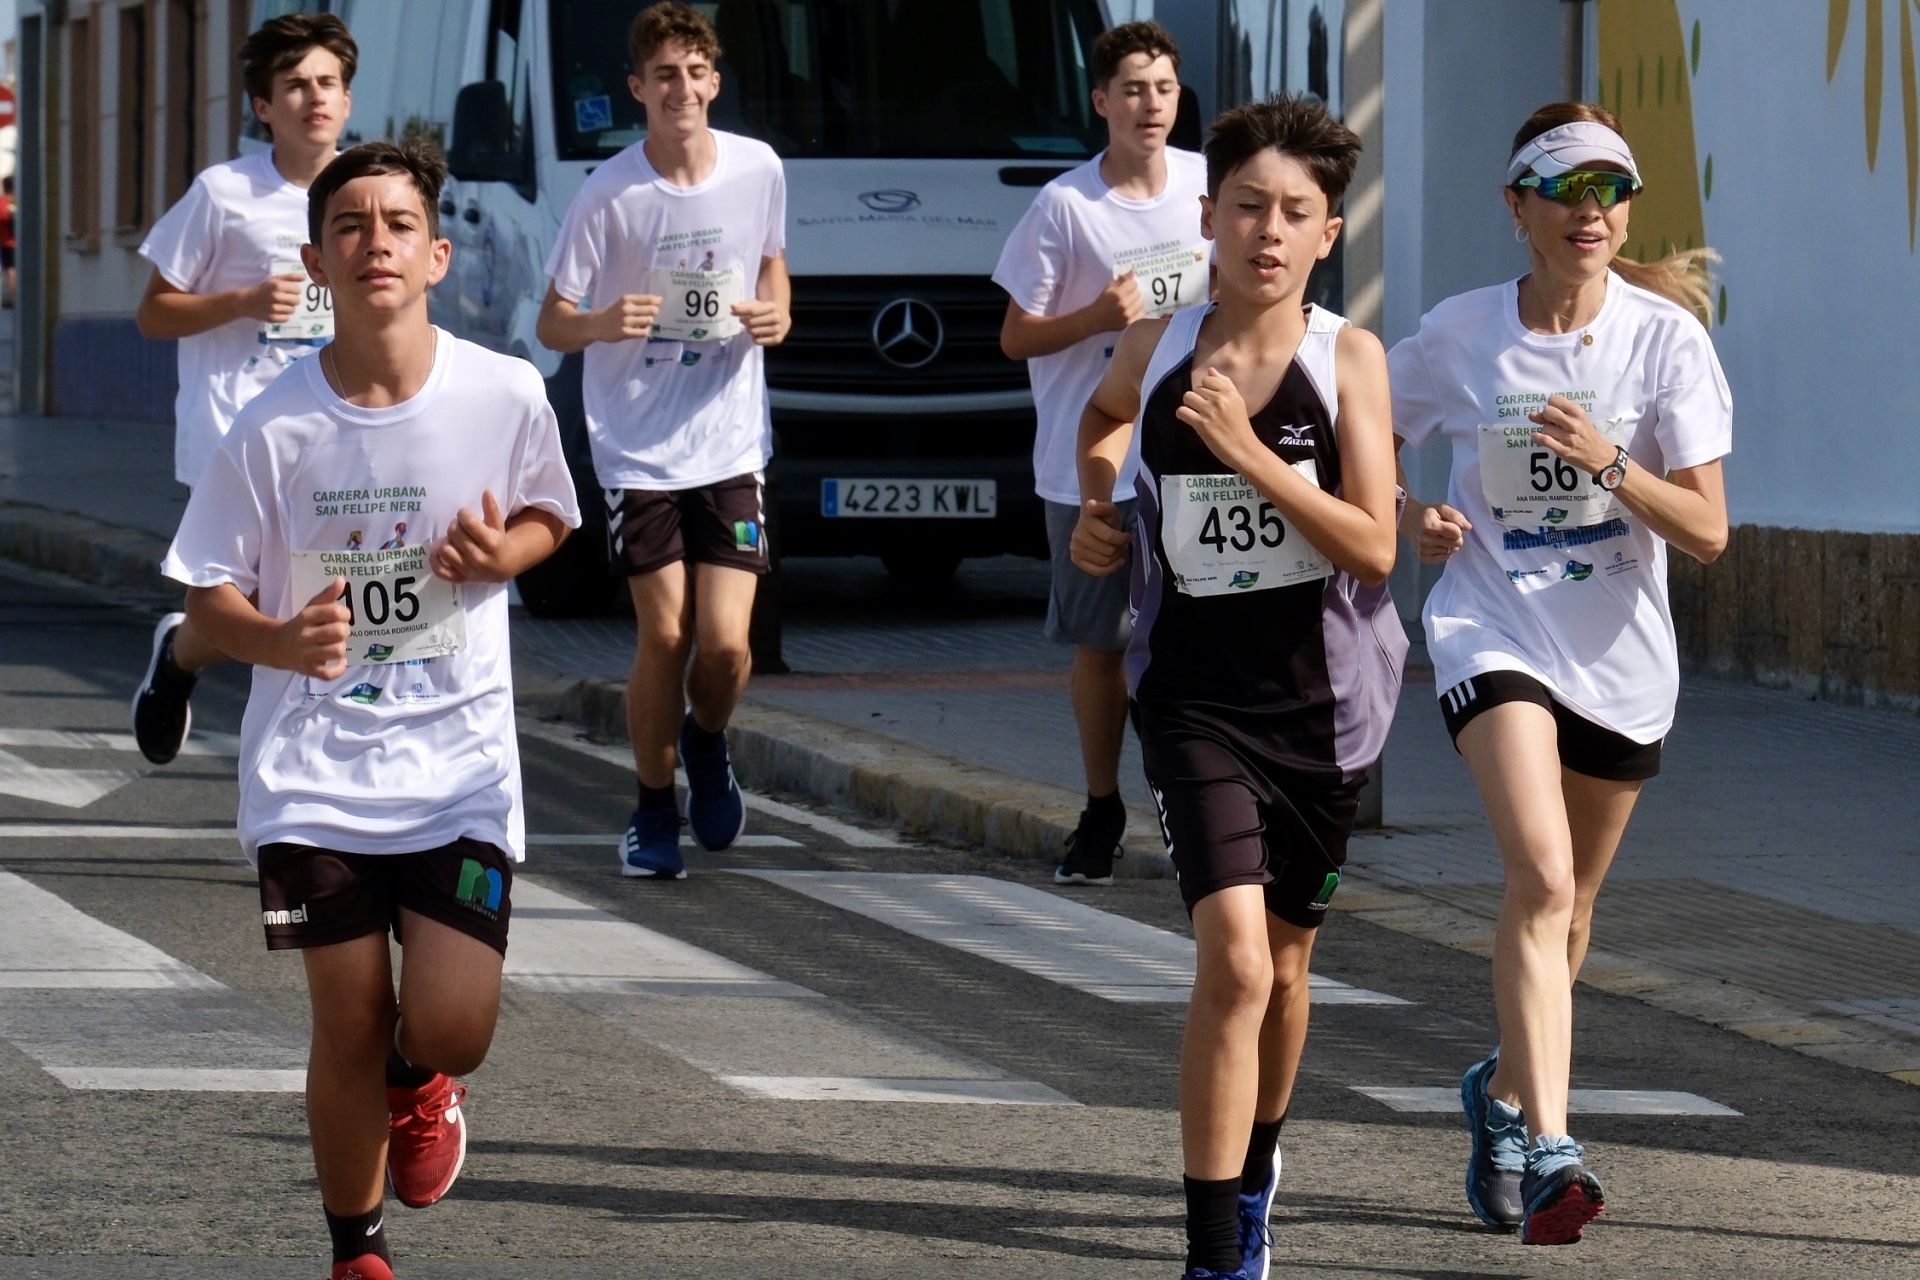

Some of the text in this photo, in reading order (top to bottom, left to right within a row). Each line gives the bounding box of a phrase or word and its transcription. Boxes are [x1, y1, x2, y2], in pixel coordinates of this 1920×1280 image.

[656, 227, 723, 244] CARRERA URBANA
[673, 238, 700, 250] FELIPE
[1113, 246, 1148, 260] CARRERA
[1149, 240, 1181, 252] URBANA
[1166, 250, 1194, 261] URBANA
[1151, 263, 1175, 274] FELIPE
[1152, 272, 1182, 306] 97
[685, 290, 719, 317] 96
[1495, 394, 1547, 405] CARRERA
[1498, 407, 1520, 418] SAN
[1278, 436, 1315, 446] MIZUNO
[1506, 438, 1527, 449] SAN
[1530, 452, 1578, 492] 56
[1186, 477, 1236, 488] CARRERA
[312, 486, 427, 502] CARRERA URBANA
[845, 484, 990, 513] 4223 KWL
[1190, 491, 1210, 502] SAN
[1213, 488, 1254, 501] FELIPE
[315, 500, 422, 516] SAN FELIPE NERI
[1198, 501, 1285, 553] 435
[320, 546, 427, 564] CARRERA URBANA
[324, 559, 424, 576] SAN FELIPE NERI
[336, 575, 420, 627] 105
[351, 629, 363, 637] ALO
[364, 628, 391, 637] ORTEGA
[263, 903, 308, 925] mmel
